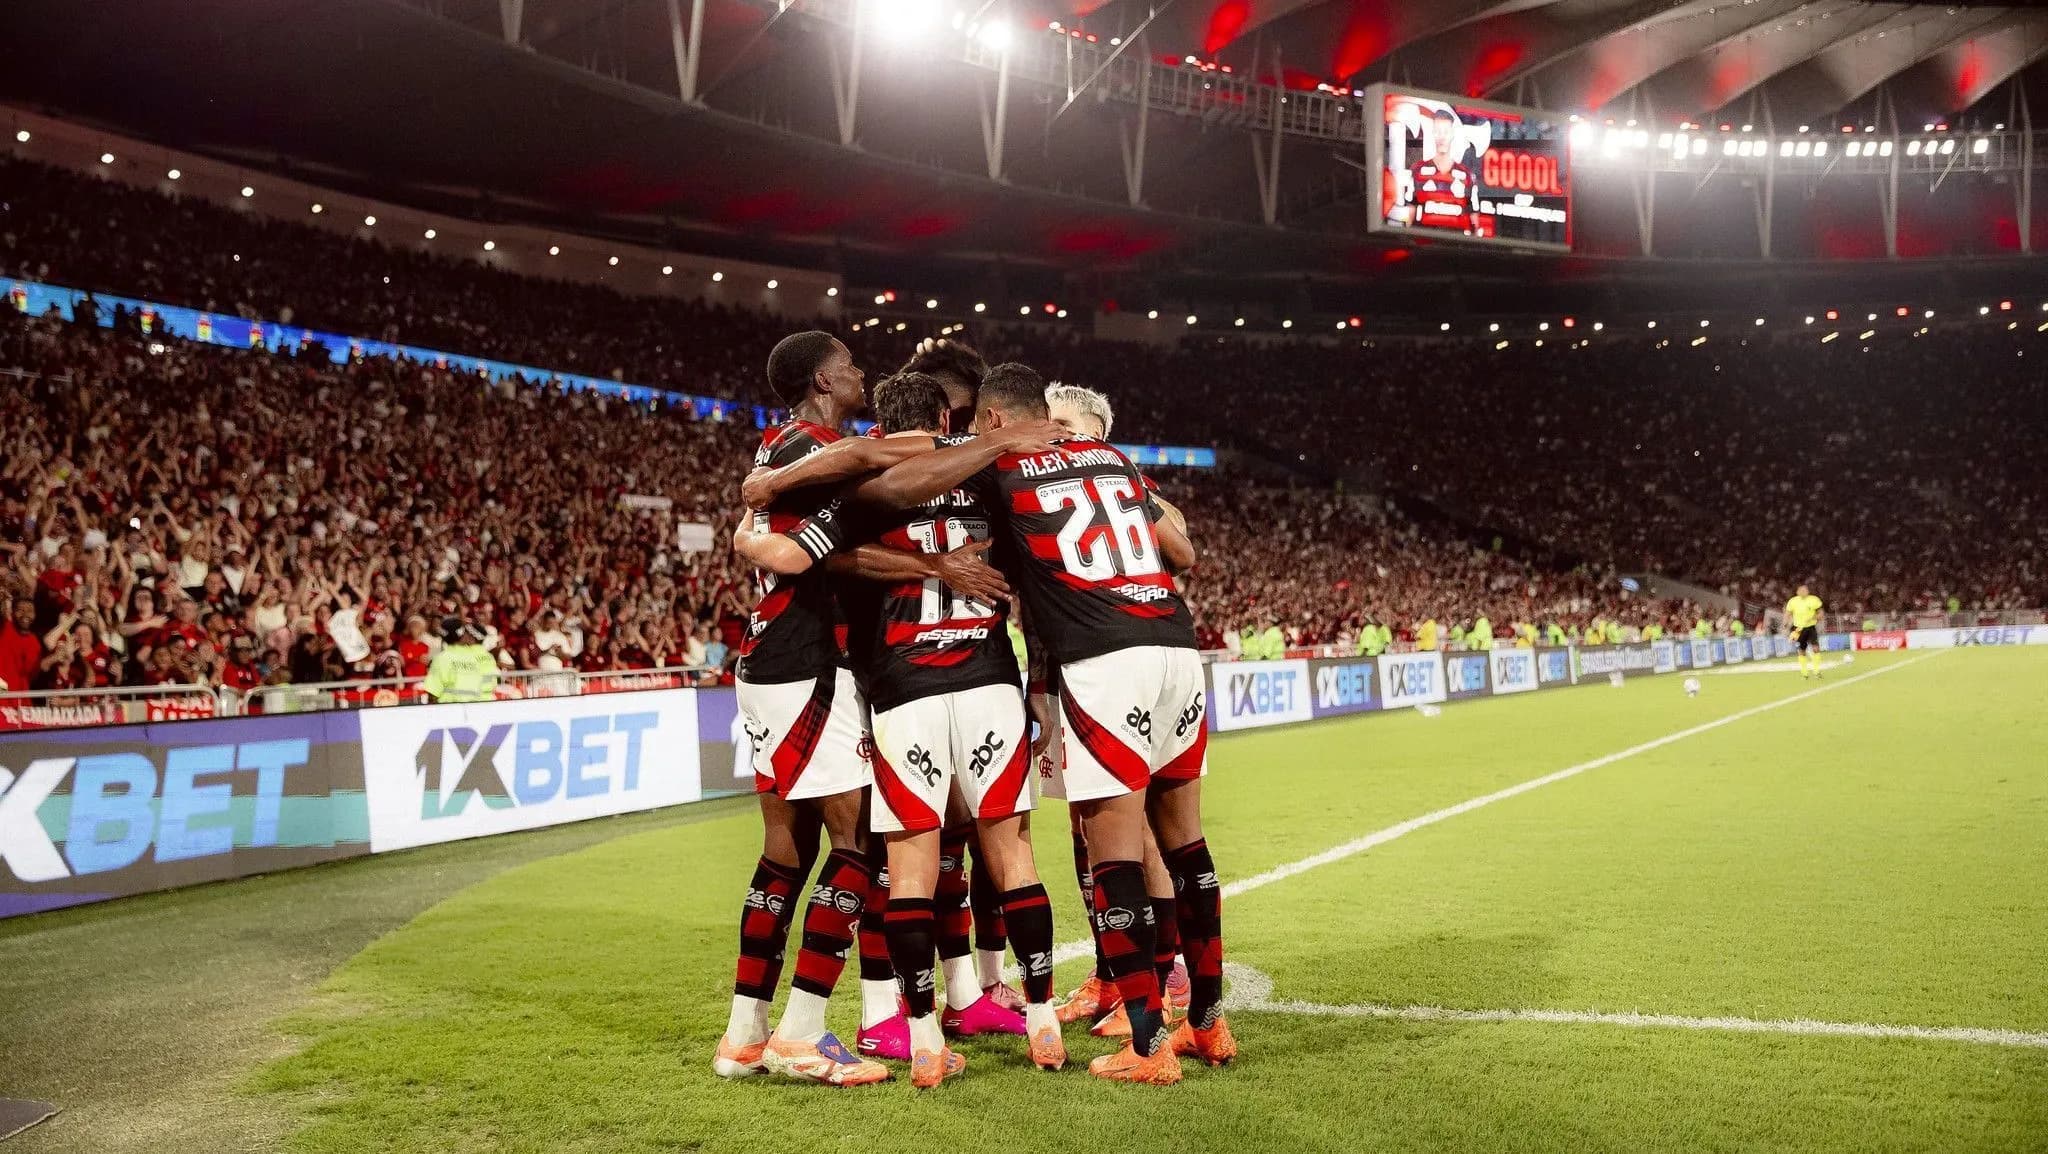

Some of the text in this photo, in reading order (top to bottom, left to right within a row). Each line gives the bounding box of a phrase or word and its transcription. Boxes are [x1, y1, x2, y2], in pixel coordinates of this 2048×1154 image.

[1482, 147, 1563, 195] GOOOL
[1018, 448, 1124, 478] ALEX SANDRO
[1051, 484, 1080, 495] TEXACO
[1036, 475, 1161, 582] 26
[1953, 627, 2034, 647] 1XBET
[1231, 670, 1298, 717] 1XBET
[1316, 664, 1373, 709] 1XBET
[1390, 661, 1434, 697] 1XBET
[1175, 691, 1203, 737] abc
[415, 711, 659, 820] 1XBET
[906, 743, 942, 788] abc
[969, 731, 1004, 778] abc
